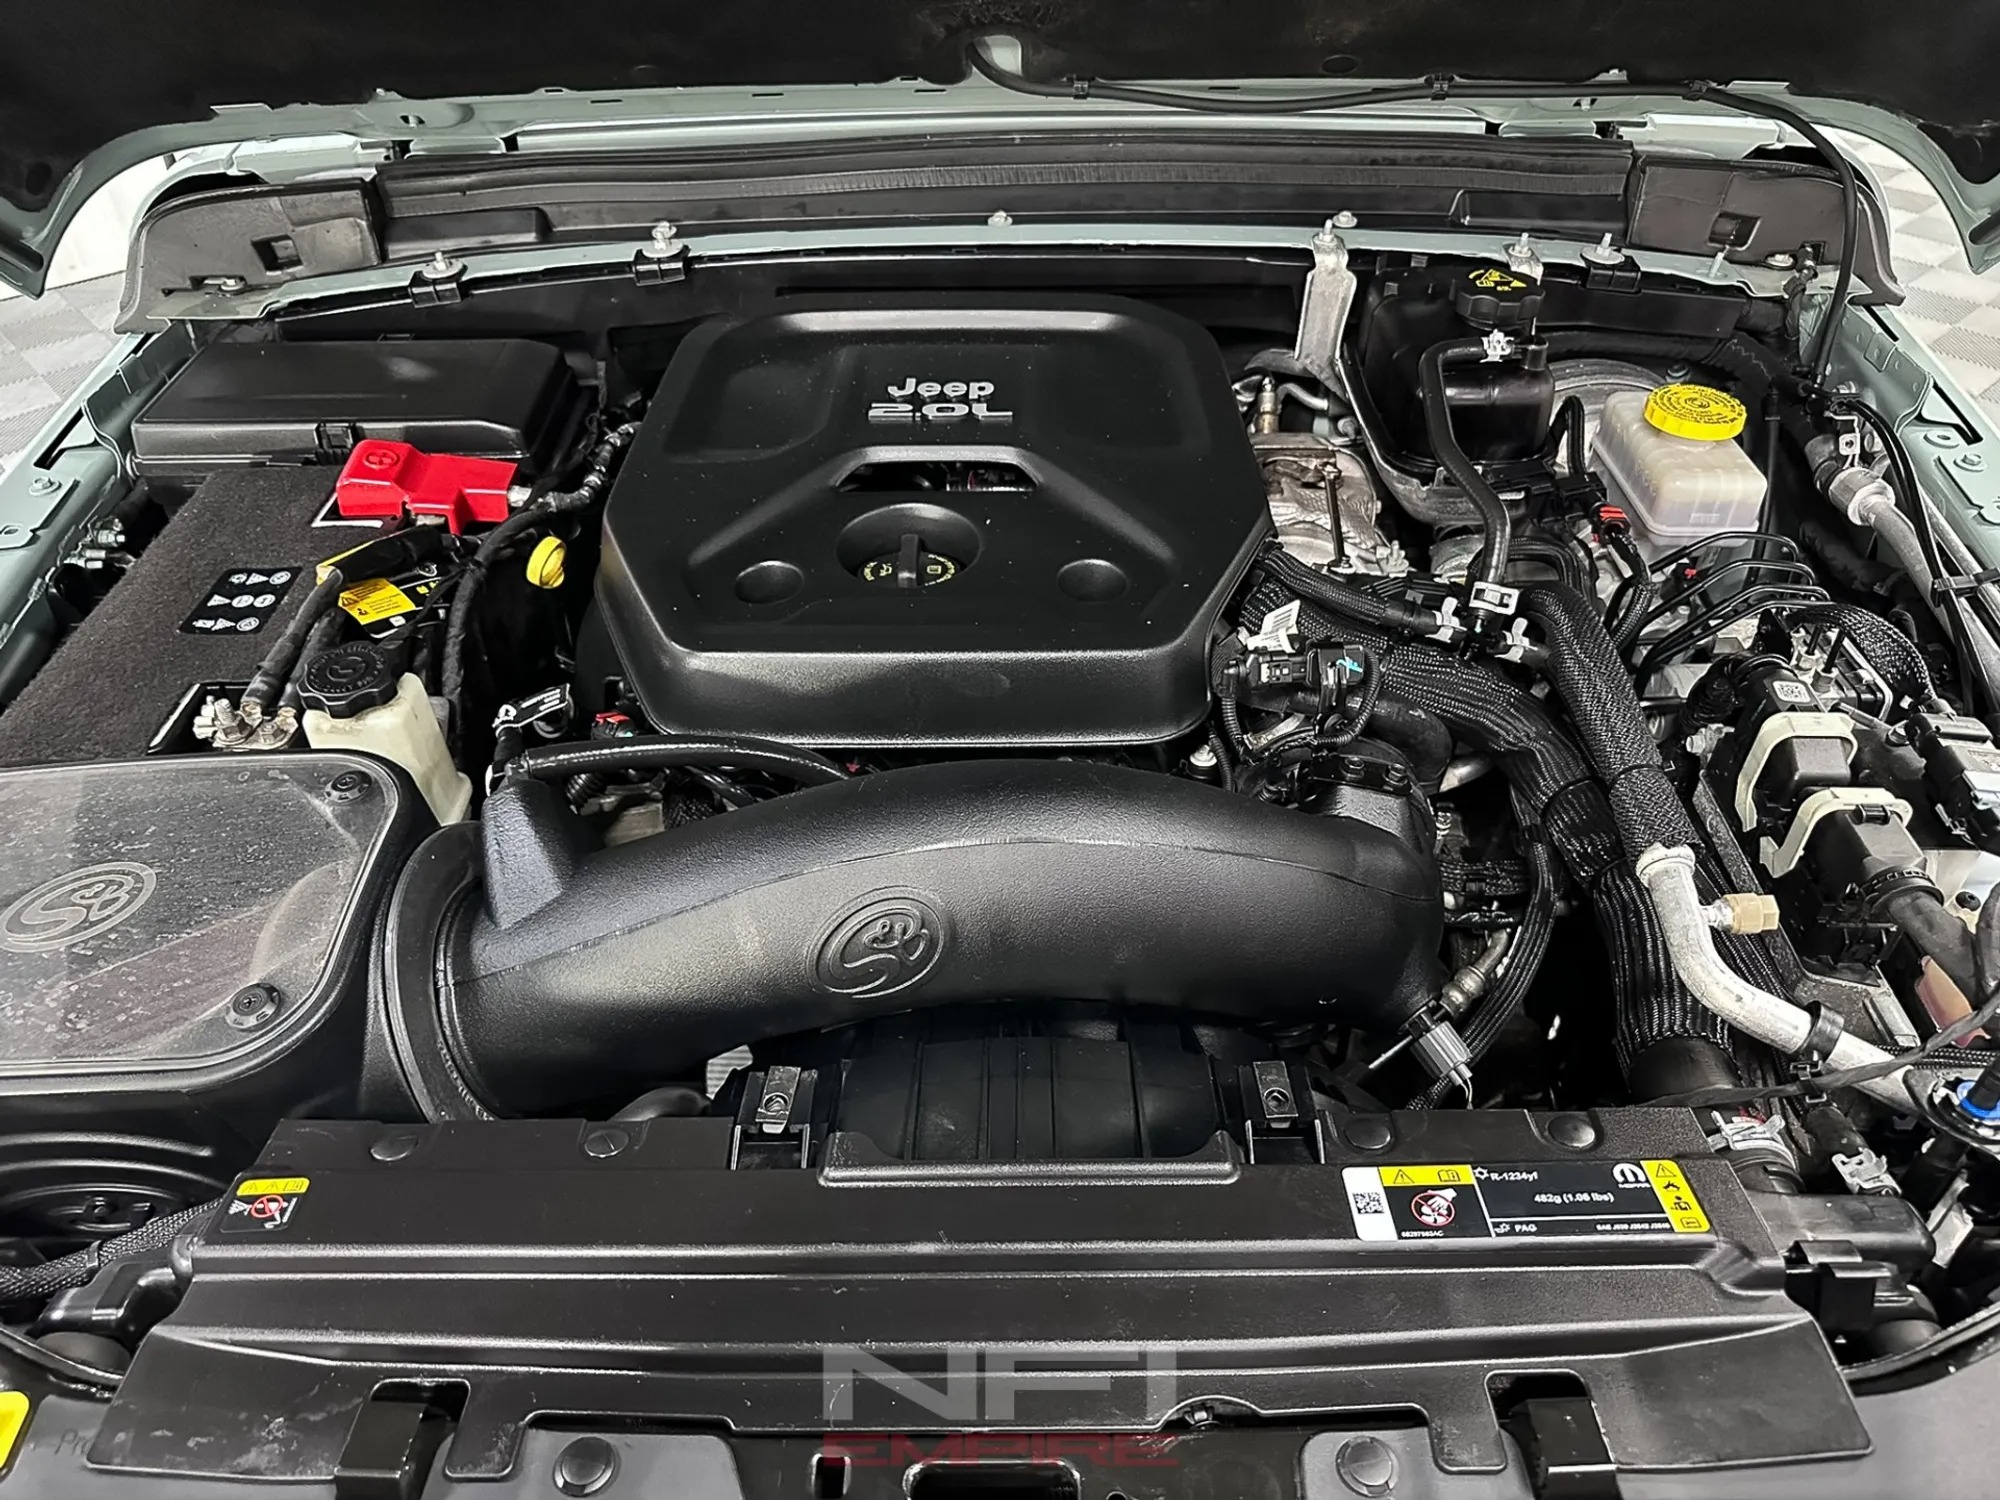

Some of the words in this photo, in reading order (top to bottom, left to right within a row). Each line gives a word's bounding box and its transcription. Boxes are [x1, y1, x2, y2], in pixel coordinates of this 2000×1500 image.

[887, 378, 995, 400] Jeep
[868, 402, 1013, 420] 2.0L
[1534, 1193, 1562, 1204] 482g
[1591, 1192, 1614, 1203] lbs)
[1515, 1223, 1537, 1232] PAG
